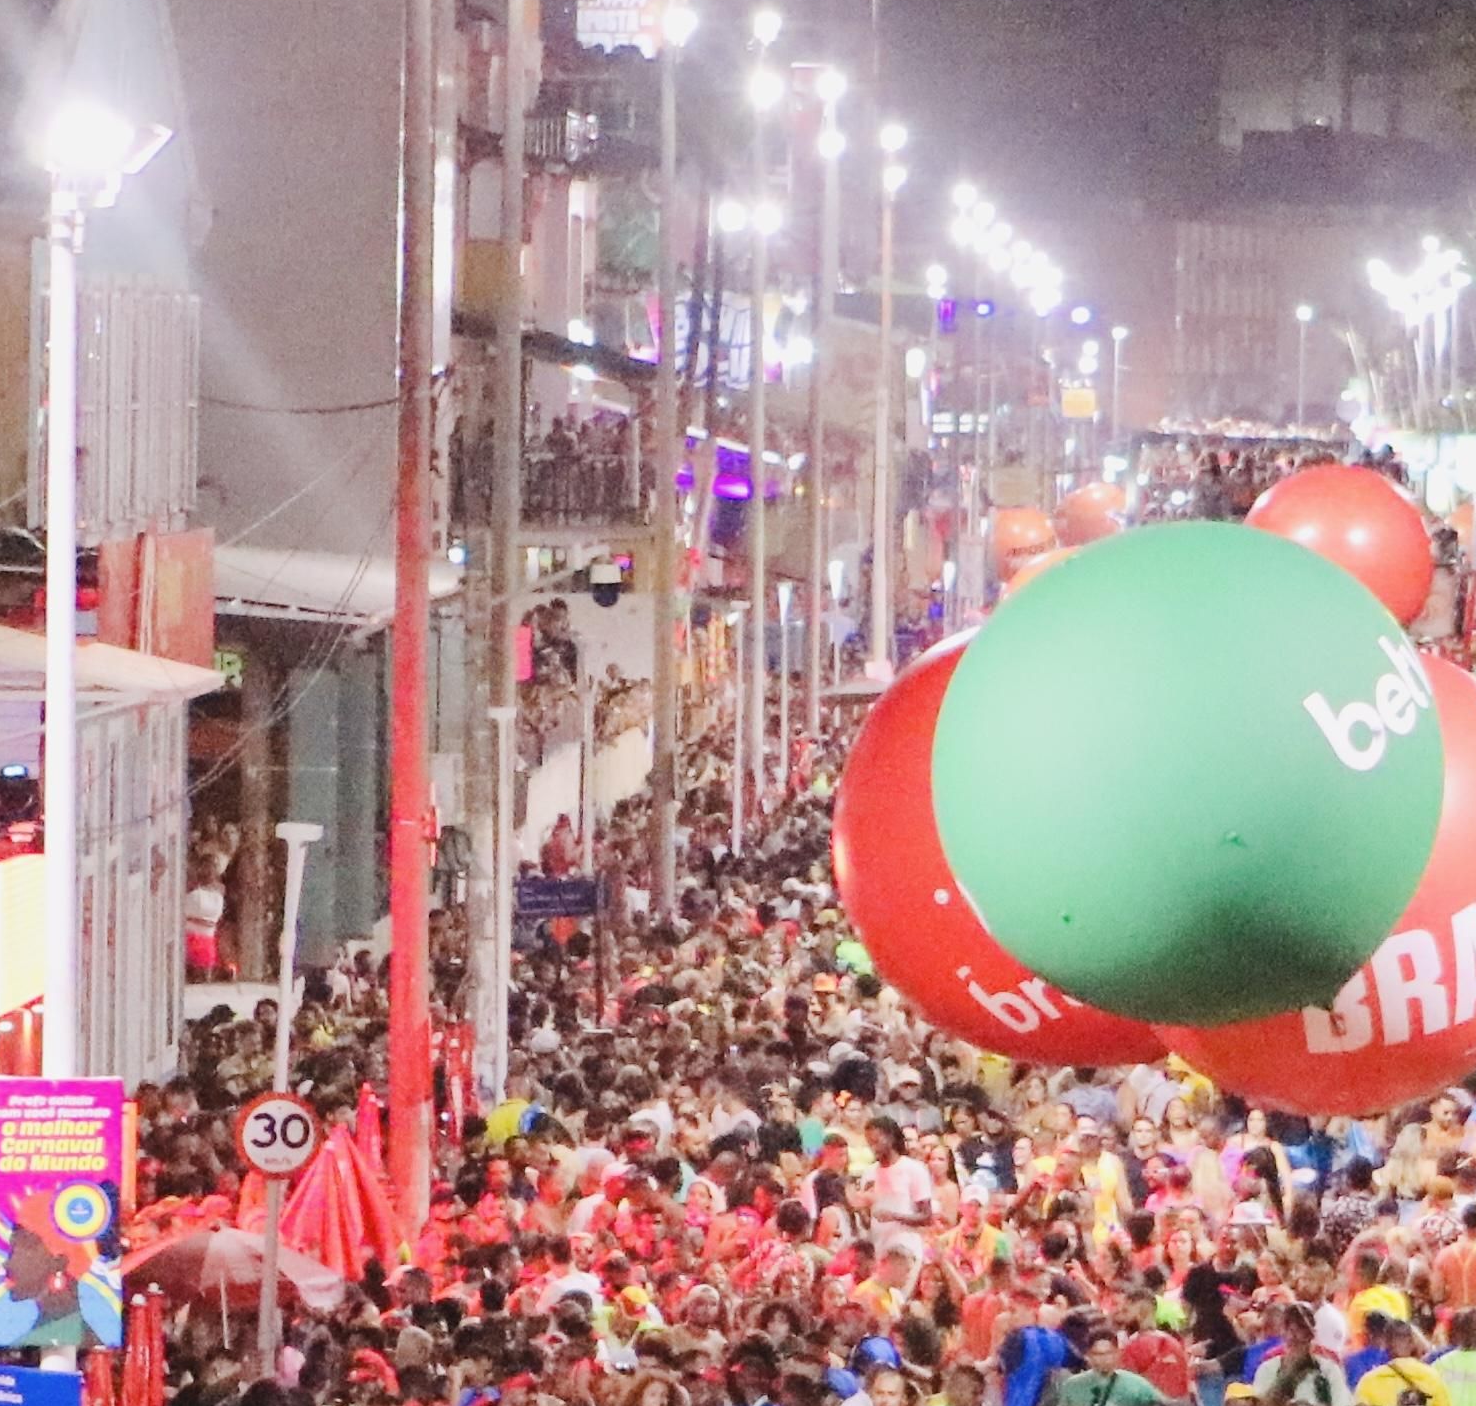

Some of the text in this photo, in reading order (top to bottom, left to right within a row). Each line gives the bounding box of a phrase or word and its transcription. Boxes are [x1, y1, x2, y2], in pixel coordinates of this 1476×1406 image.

[19, 1120, 104, 1136] melhor
[251, 1113, 310, 1149] 30
[0, 1137, 104, 1154] Carnaval
[29, 1155, 107, 1172] Mundo
